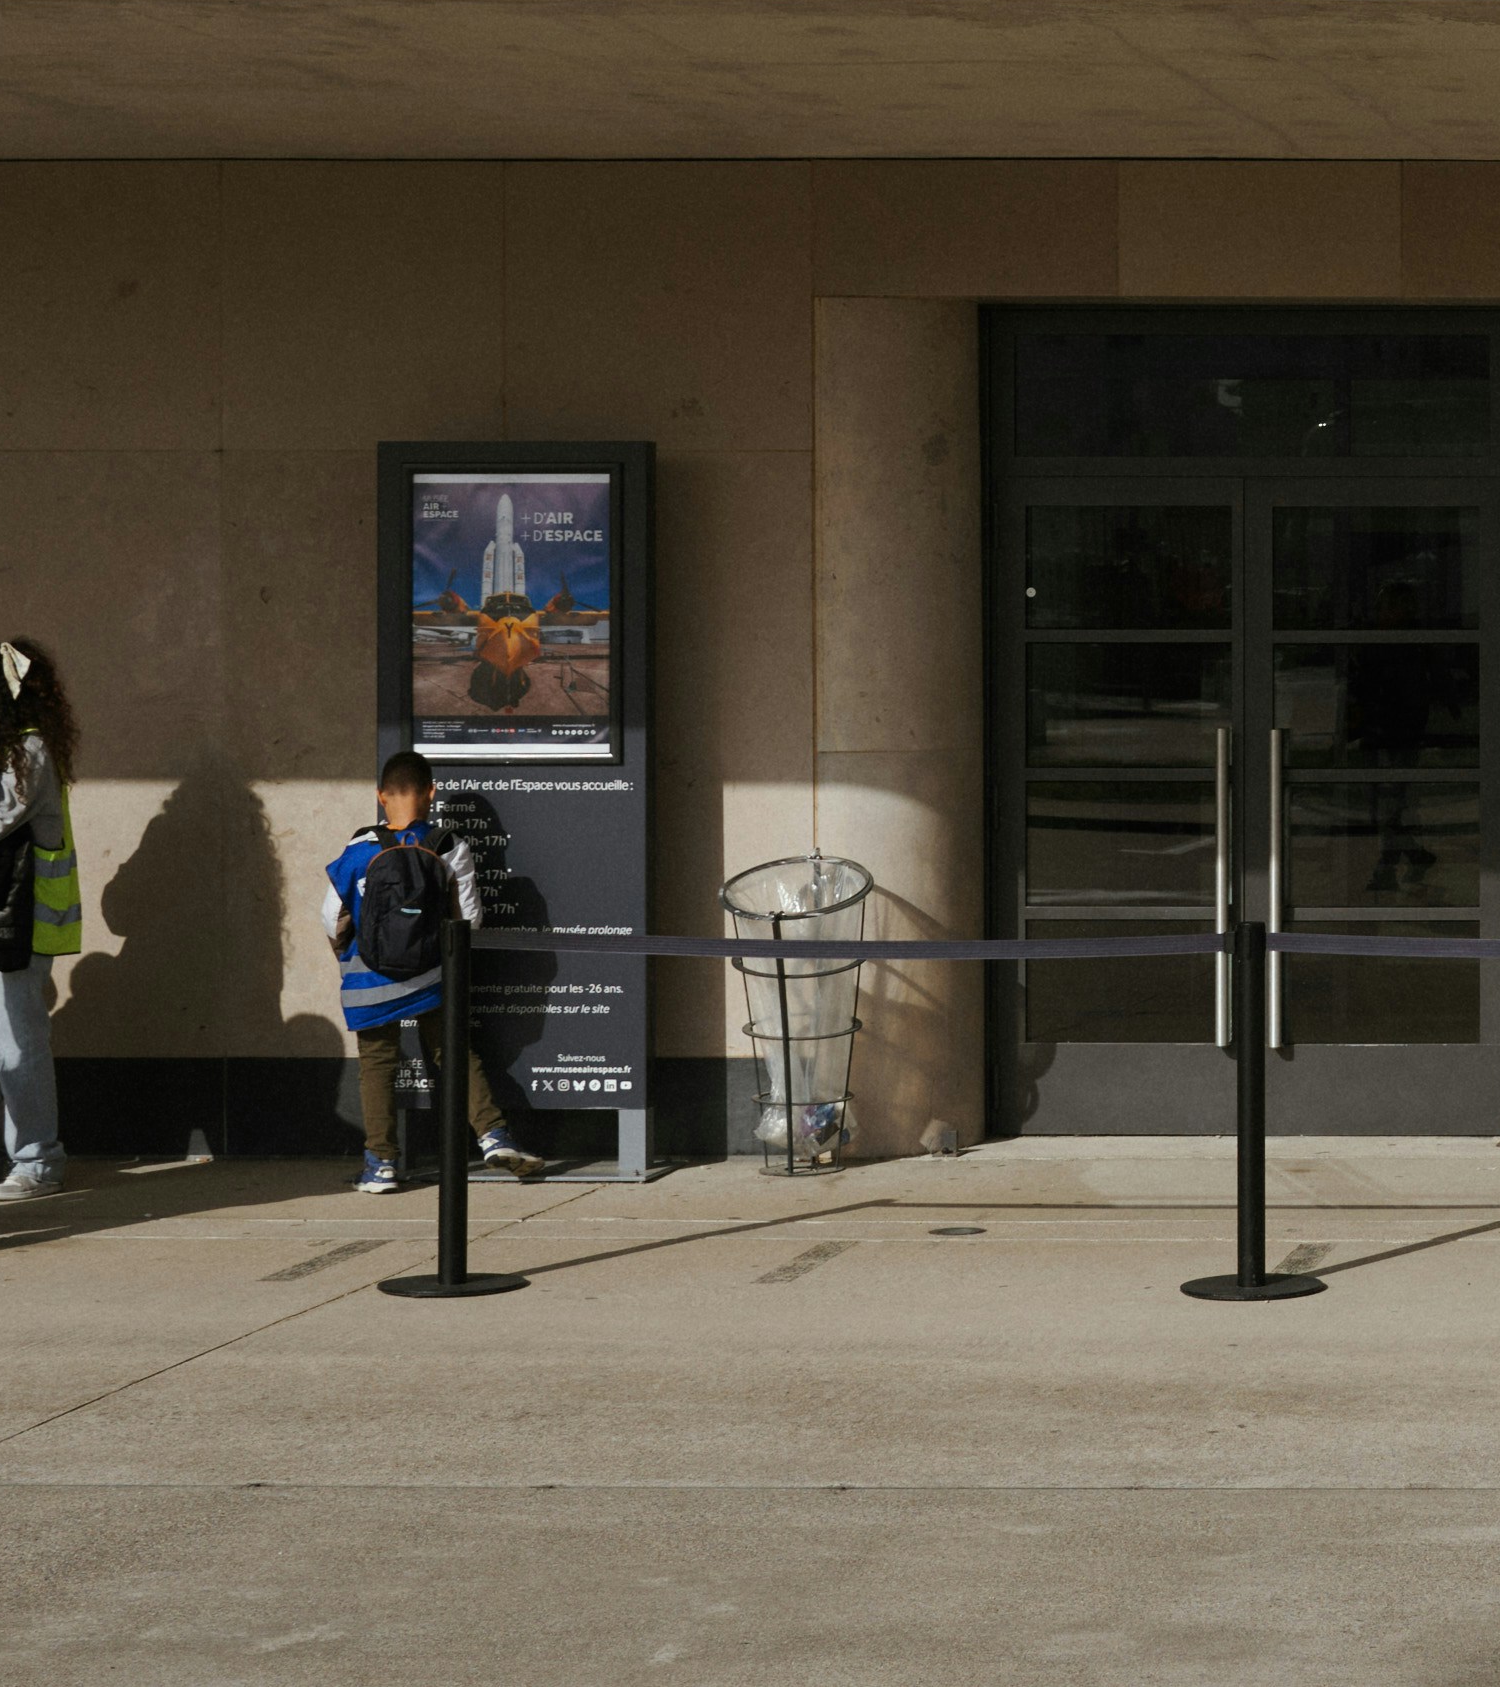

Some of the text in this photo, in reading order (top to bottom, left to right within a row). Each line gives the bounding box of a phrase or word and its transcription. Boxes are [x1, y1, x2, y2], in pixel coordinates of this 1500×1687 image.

[422, 502, 440, 510] AIR
[422, 510, 459, 518] ESPACE
[533, 512, 574, 525] D'AIR
[533, 530, 603, 542] D'ESPACE
[445, 778, 460, 791] de
[461, 778, 482, 791] l'Air
[482, 779, 494, 791] et
[495, 778, 509, 791] de
[510, 778, 553, 793] l'Espace
[554, 781, 581, 791] vous
[582, 778, 629, 791] accueille
[435, 800, 476, 813] Fermé
[463, 834, 511, 846] 0h-17h
[474, 868, 512, 880] h-17h
[553, 924, 587, 935] musée
[587, 924, 634, 936] prolonge
[504, 983, 543, 995] gratuite
[544, 985, 567, 995] pour
[569, 983, 584, 993] les
[585, 983, 602, 993] -26
[603, 984, 624, 994] ans.
[507, 1003, 562, 1015] disponibles
[563, 1005, 579, 1014] sur
[581, 1003, 591, 1014] le
[592, 1004, 610, 1014] site
[399, 1058, 423, 1069] USÉE
[557, 1053, 606, 1062] Suivez-nous
[397, 1069, 412, 1078] IR
[531, 1065, 632, 1075] www.museeairespace.fr
